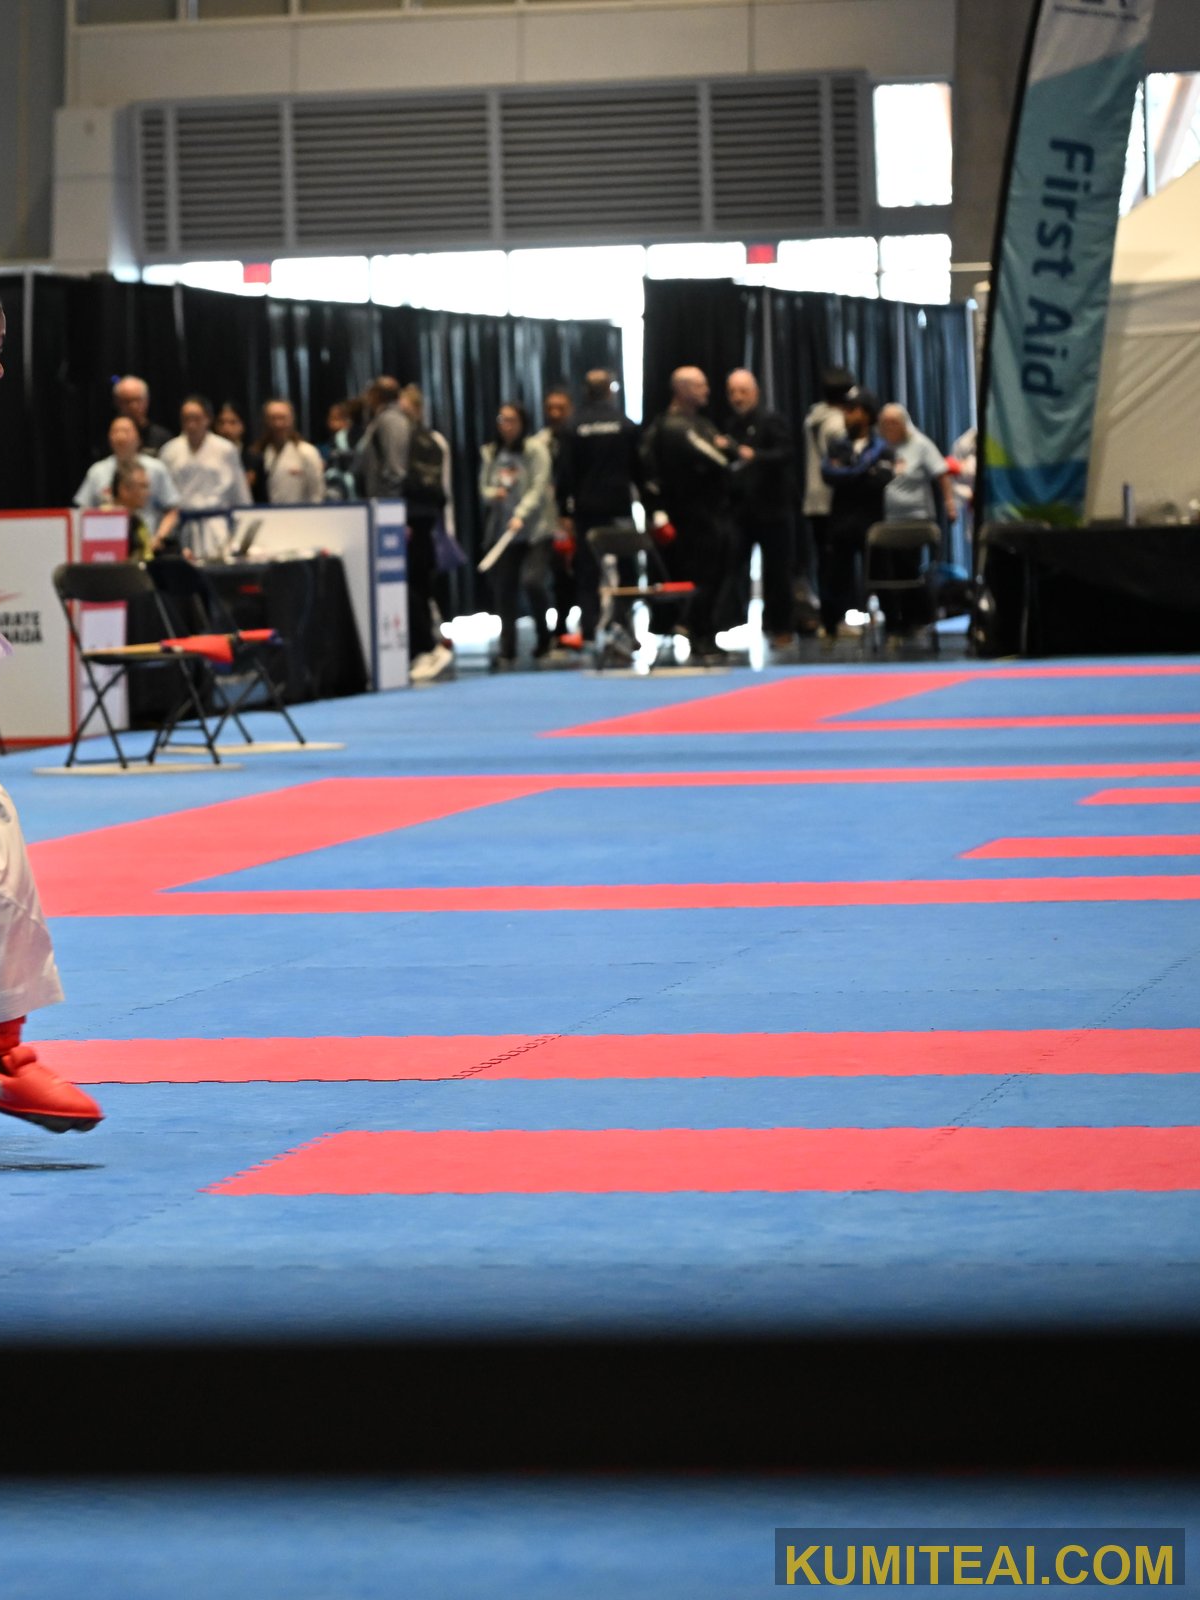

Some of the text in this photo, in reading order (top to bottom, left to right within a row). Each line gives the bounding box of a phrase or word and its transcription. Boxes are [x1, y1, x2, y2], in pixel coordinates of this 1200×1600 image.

[1019, 137, 1095, 399] First Aid
[2, 628, 43, 644] NADA
